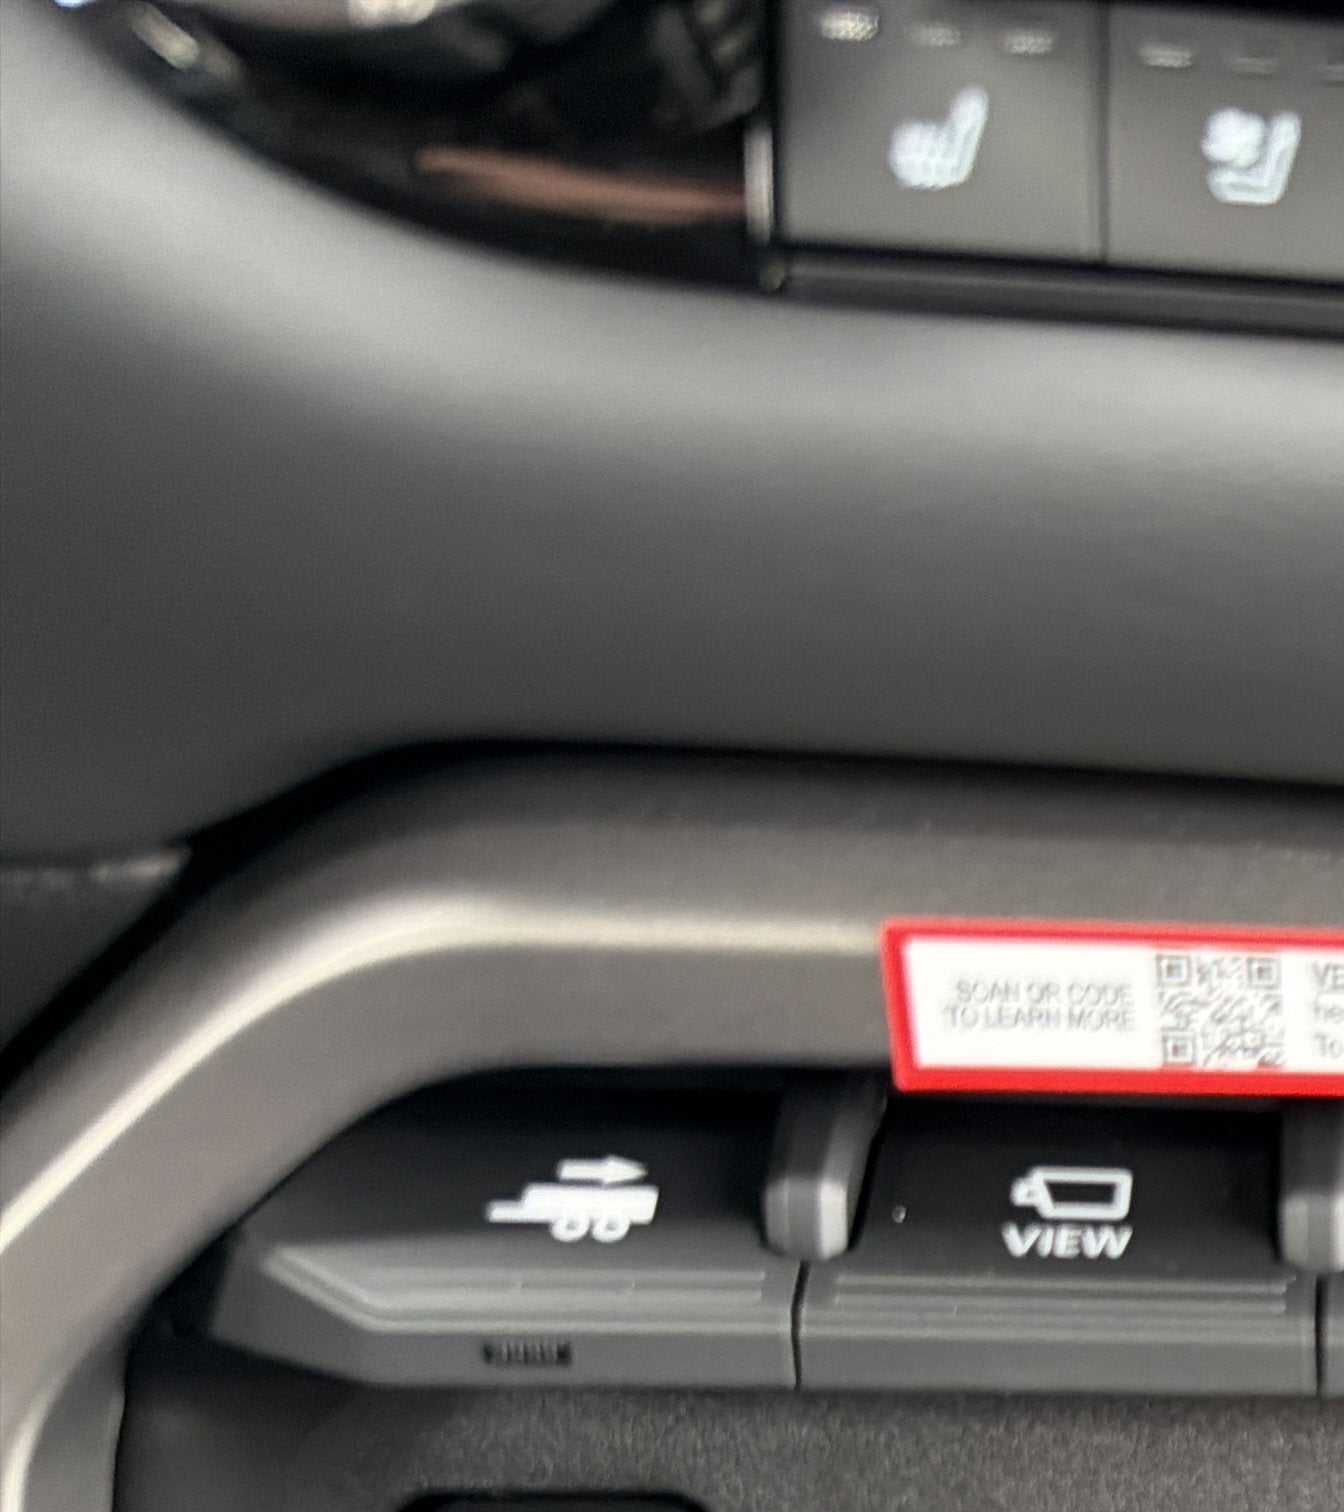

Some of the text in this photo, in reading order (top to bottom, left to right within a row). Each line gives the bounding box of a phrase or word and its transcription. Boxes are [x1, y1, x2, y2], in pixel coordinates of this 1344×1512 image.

[956, 979, 1135, 1007] SCAN QR CODE
[945, 1005, 1137, 1032] TO LEARN MORE
[1312, 1030, 1344, 1059] To
[1002, 1222, 1134, 1259] VIEW
